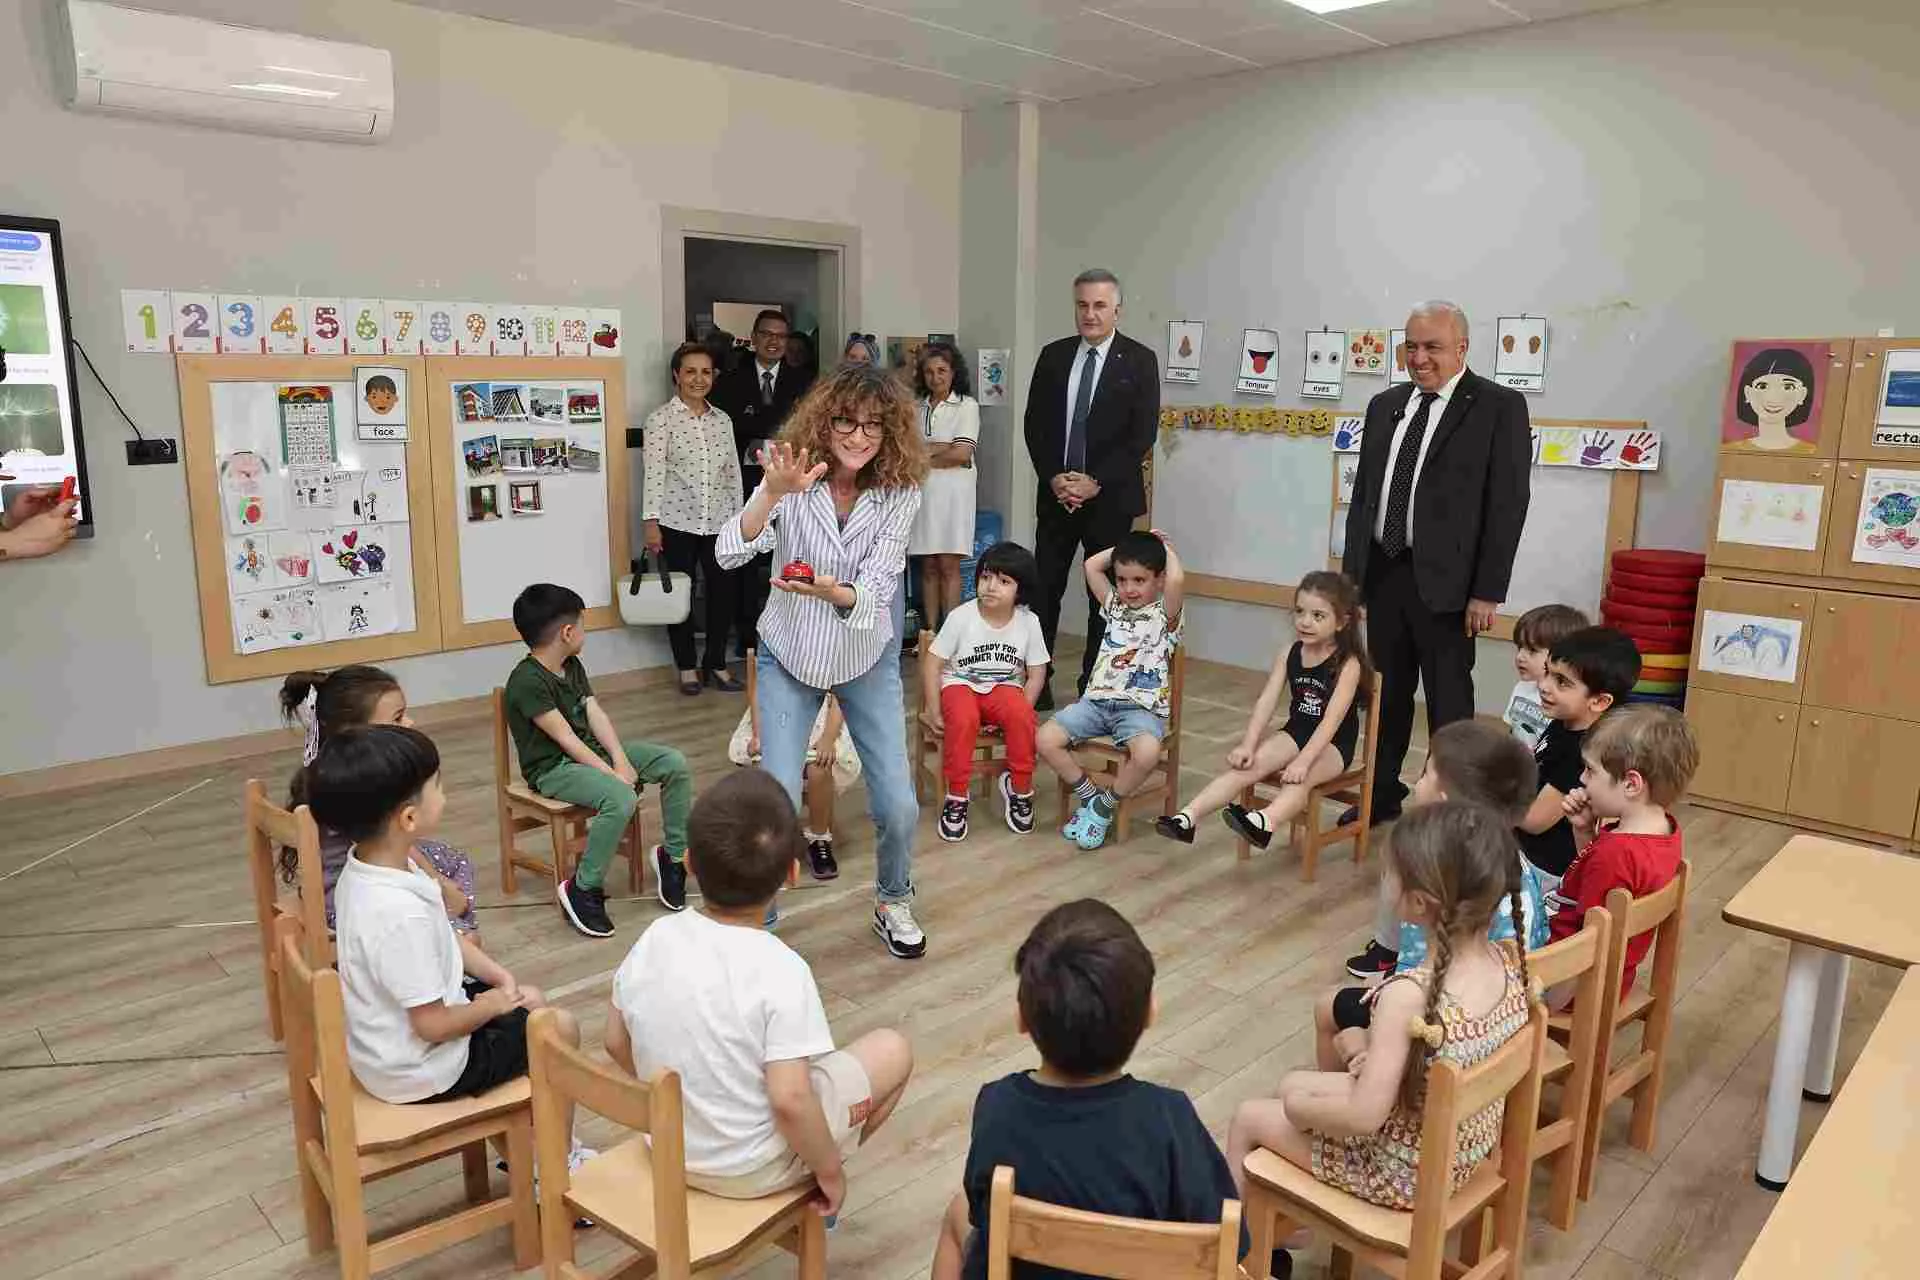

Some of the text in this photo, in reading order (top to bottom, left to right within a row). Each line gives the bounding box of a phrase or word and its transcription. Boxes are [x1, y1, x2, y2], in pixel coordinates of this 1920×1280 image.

[138, 302, 588, 344] 1 2 3 4 5 6 7 8 9 10 11 12
[1245, 381, 1270, 390] tongue
[1508, 378, 1528, 386] ears
[1313, 385, 1330, 393] eyes
[373, 427, 395, 437] face
[1876, 432, 1920, 444] recta
[973, 643, 1018, 655] READY FOR
[958, 652, 992, 668] SUMMER
